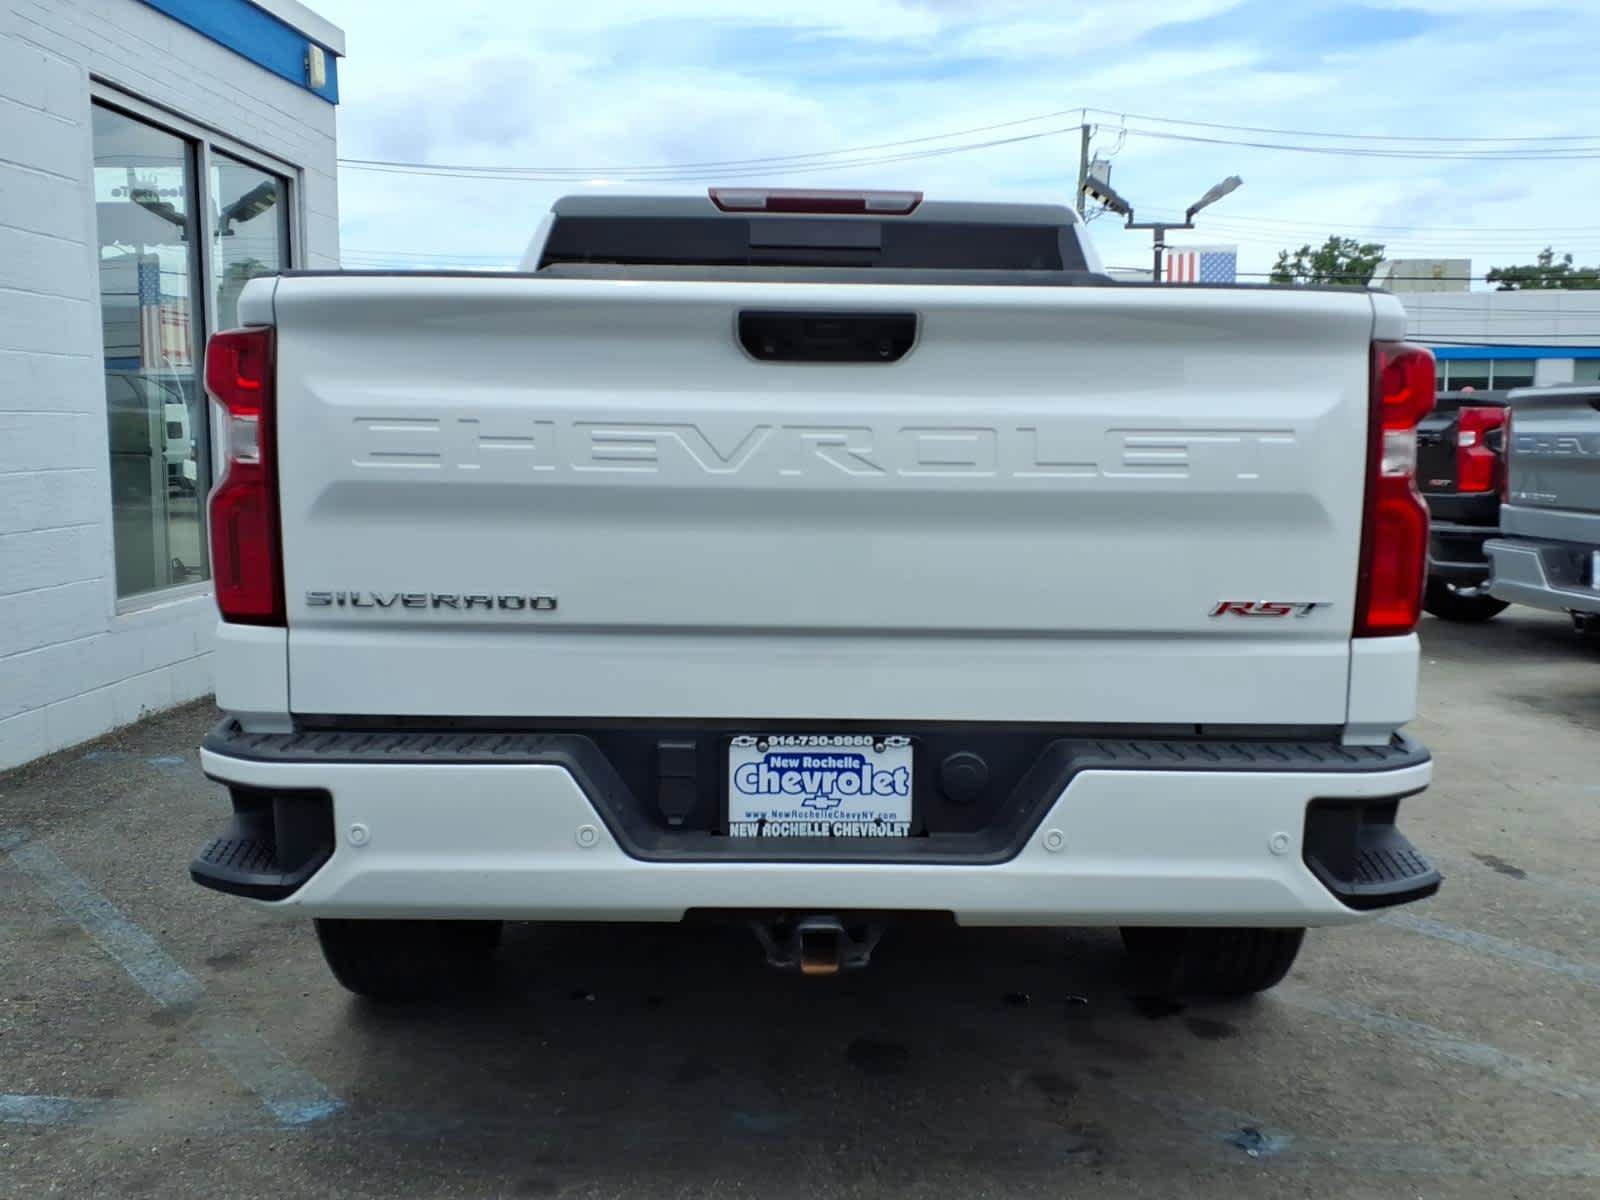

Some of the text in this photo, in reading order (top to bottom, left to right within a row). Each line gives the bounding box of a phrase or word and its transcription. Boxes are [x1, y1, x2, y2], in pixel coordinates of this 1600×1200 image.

[352, 417, 1297, 480] CHEVROLET
[305, 590, 558, 611] SILVERADO
[1207, 599, 1335, 618] RST
[770, 756, 861, 769] New Rochelle
[735, 762, 910, 796] Chevrolet
[729, 821, 911, 837] NEW ROCHELLE CHEVROLET
